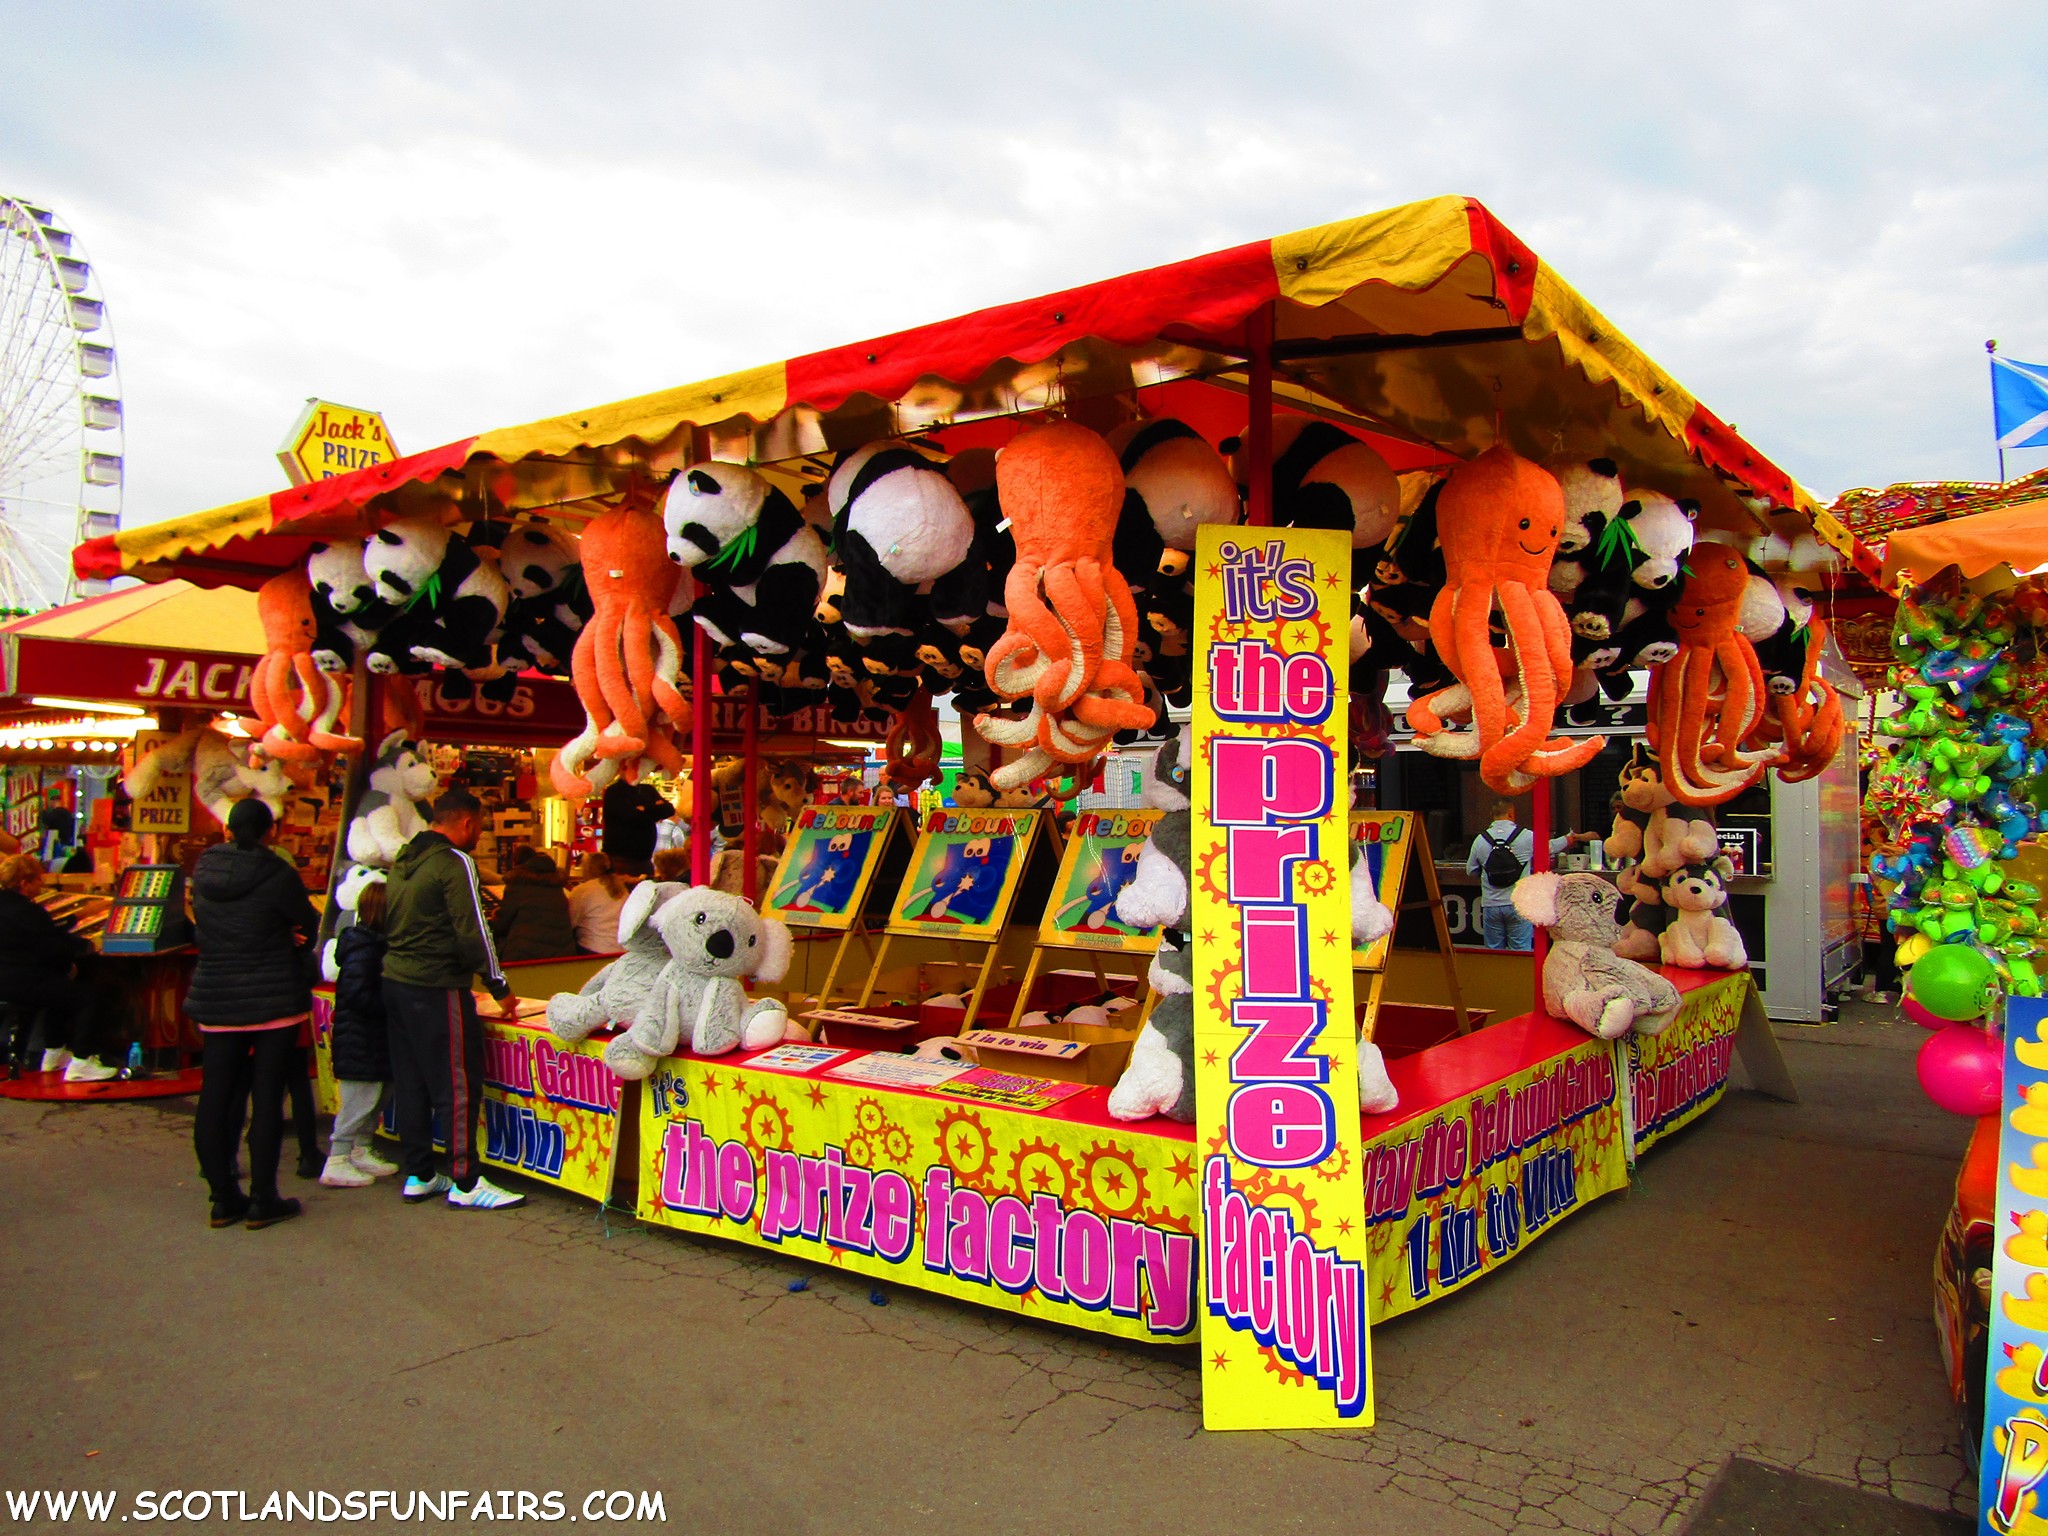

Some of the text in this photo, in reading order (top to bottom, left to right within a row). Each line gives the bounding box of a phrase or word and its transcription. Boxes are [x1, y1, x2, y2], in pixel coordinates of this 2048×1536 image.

[315, 411, 382, 442] Jack's
[323, 441, 381, 470] PRIZE
[1219, 540, 1318, 623] it's
[1209, 639, 1334, 726] the
[139, 807, 183, 825] PRIZE
[145, 785, 182, 803] ANY
[798, 809, 890, 832] Rebound
[927, 811, 1032, 837] Rebound
[1077, 813, 1158, 838] Rebou
[1716, 832, 1745, 840] ecials
[1210, 737, 1335, 1169] prize
[966, 1032, 1048, 1051] 1 in to win
[534, 1036, 624, 1117] Game
[649, 1069, 690, 1118] it's
[484, 1096, 566, 1179] Win
[1416, 1113, 1467, 1200] the
[1469, 1060, 1562, 1176] Rebound
[1559, 1048, 1616, 1127] Game
[660, 1118, 1198, 1335] the prize factory
[1407, 1146, 1578, 1301] 1 in to Win
[1202, 1154, 1365, 1418] factory
